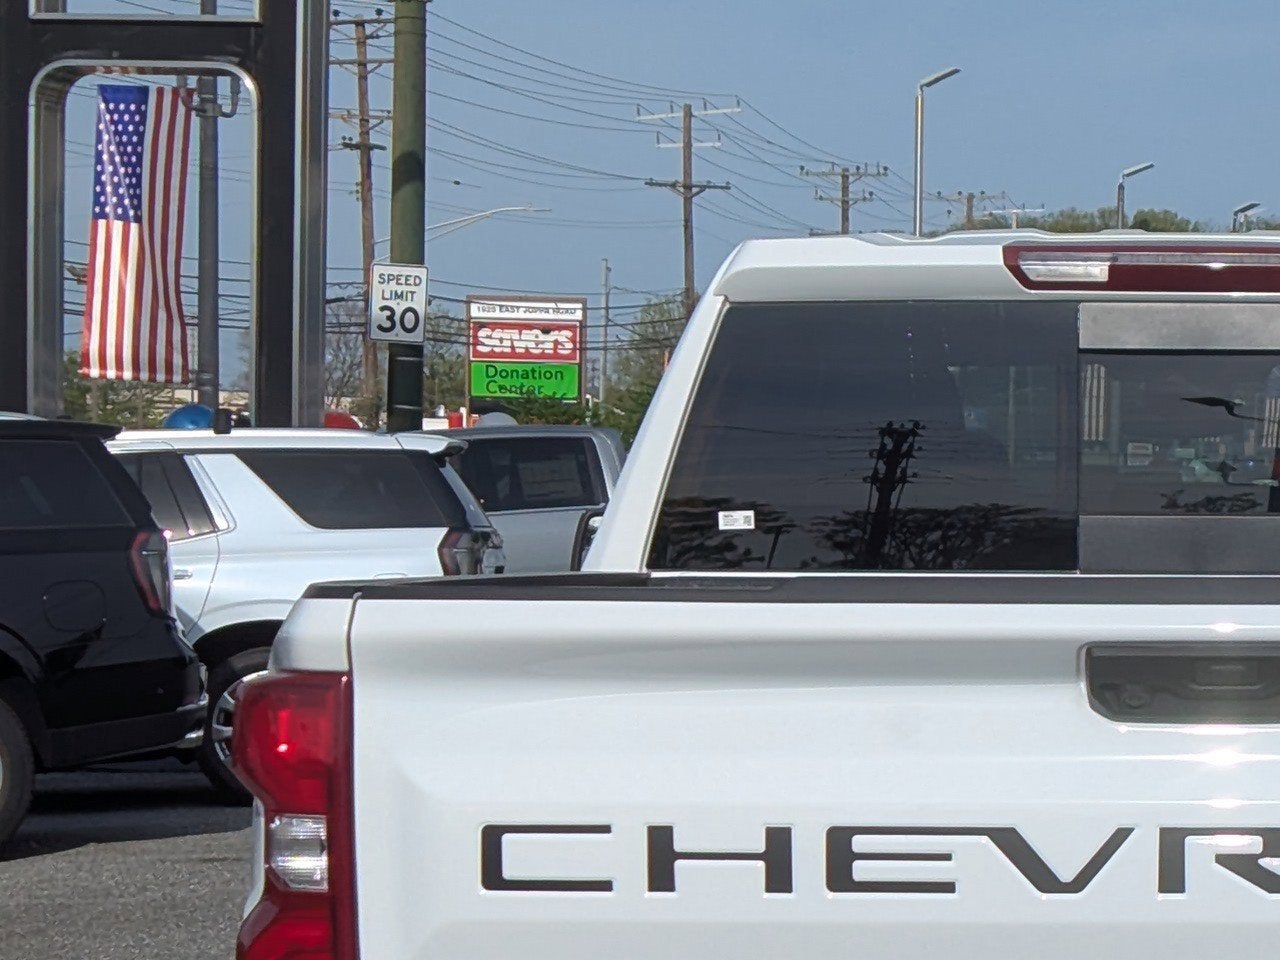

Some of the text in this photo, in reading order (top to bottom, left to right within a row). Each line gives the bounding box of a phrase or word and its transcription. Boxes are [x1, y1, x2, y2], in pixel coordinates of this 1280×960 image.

[378, 273, 422, 287] SPEED
[381, 289, 417, 302] LIMIT
[376, 305, 420, 334] 30
[485, 364, 564, 381] Donation
[486, 380, 545, 395] Center
